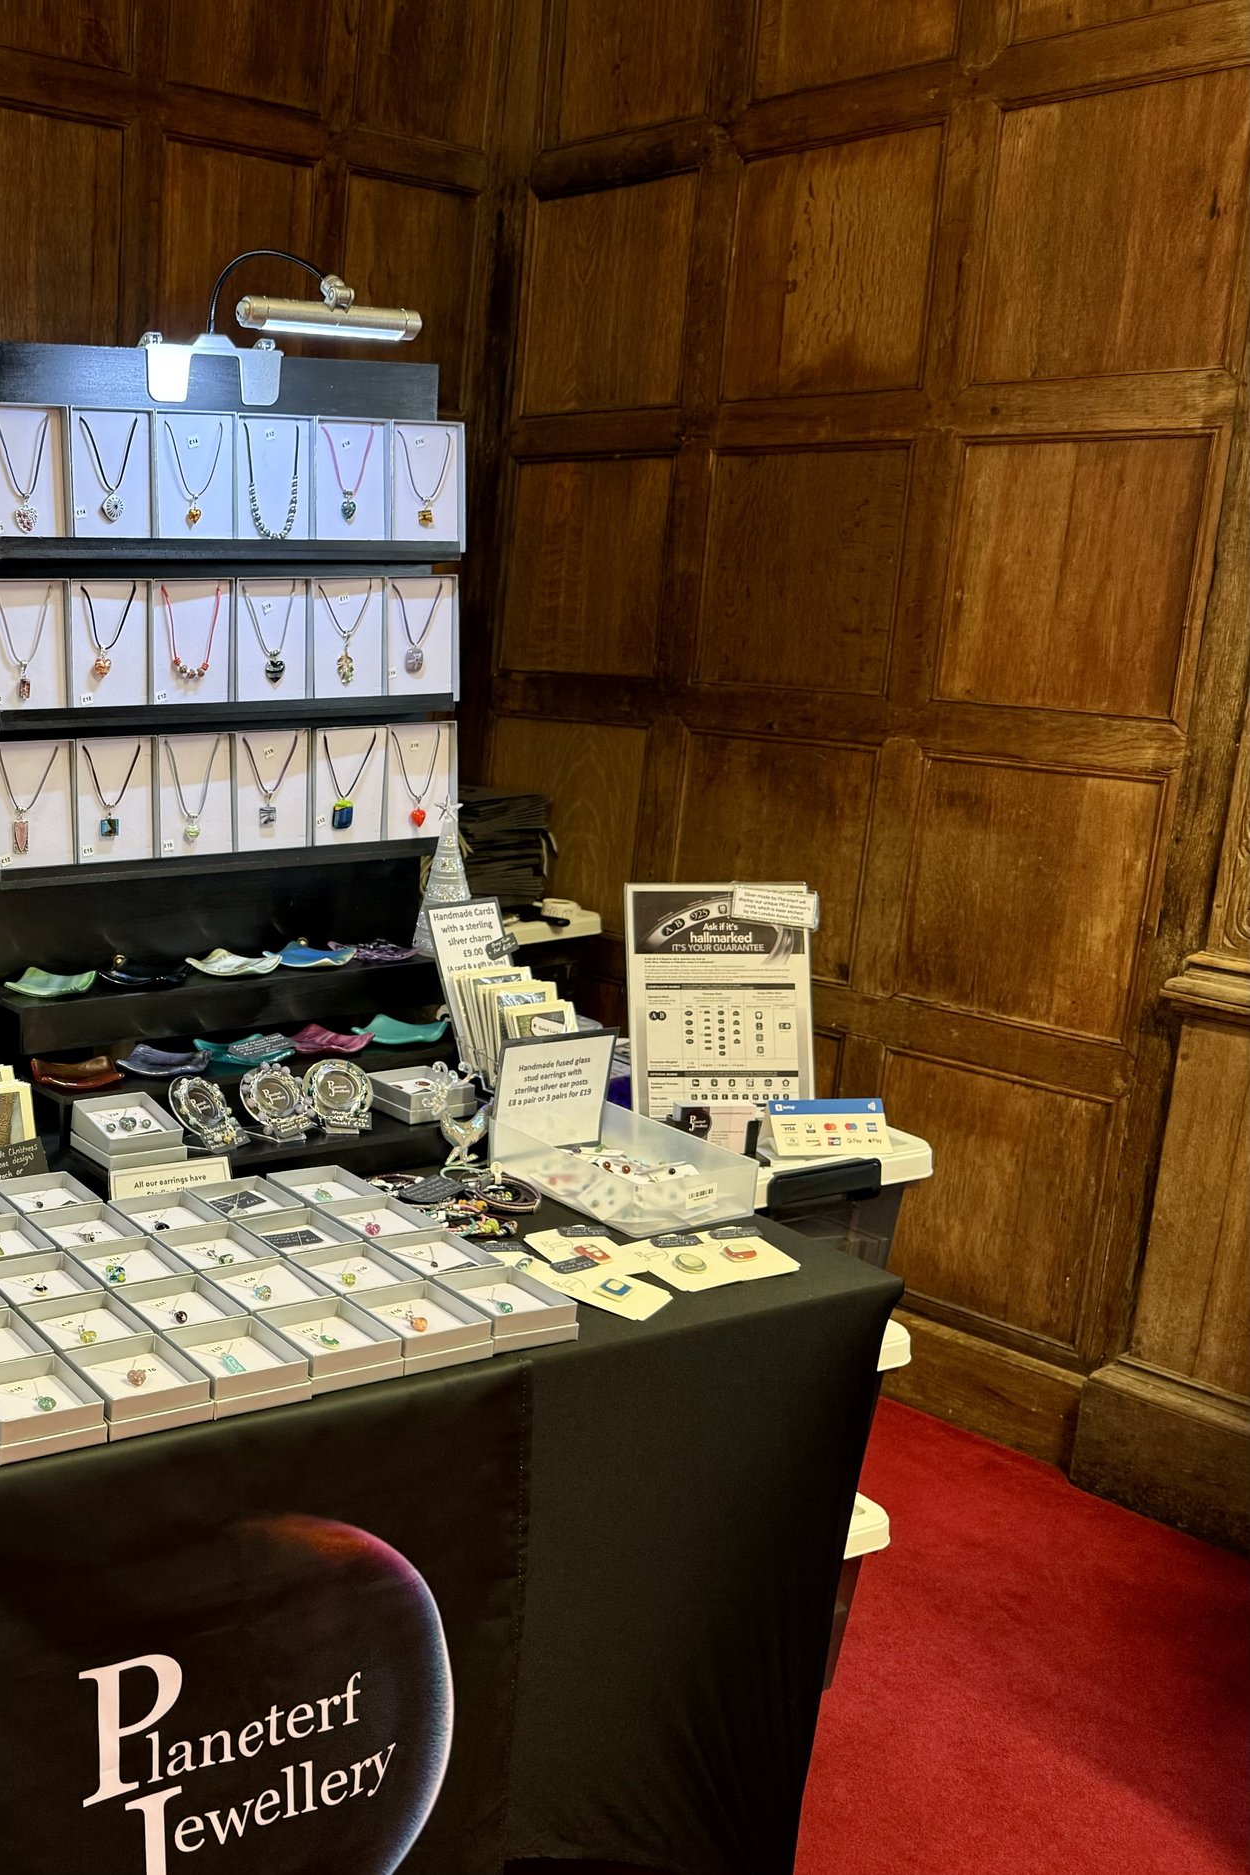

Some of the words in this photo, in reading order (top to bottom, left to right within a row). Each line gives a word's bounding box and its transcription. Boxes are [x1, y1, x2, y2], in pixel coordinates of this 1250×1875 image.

[434, 910, 472, 921] Handmade
[474, 907, 495, 916] Cards
[441, 924, 459, 933] with
[466, 921, 493, 931] sterling
[703, 923, 718, 931] Ask
[719, 923, 725, 931] if
[726, 922, 739, 931] it's
[448, 937, 468, 946] silver
[469, 934, 492, 943] charm
[690, 932, 753, 943] hallmarked
[463, 947, 483, 958] £9.00
[518, 1061, 554, 1072] Handmade
[555, 1059, 574, 1067] fused
[575, 1057, 591, 1066] glass
[524, 1074, 539, 1082] stud
[540, 1071, 566, 1080] earrings
[568, 1068, 582, 1076] with
[514, 1084, 539, 1095] sterling
[540, 1082, 558, 1091] silver
[570, 1079, 588, 1089] posts
[508, 1099, 517, 1107] £8
[523, 1097, 536, 1106] pair
[551, 1091, 567, 1101] pairs
[568, 1090, 578, 1098] for
[579, 1088, 592, 1097] £19
[8, 1144, 38, 1157] Christmas
[134, 1181, 144, 1189] All
[159, 1176, 188, 1185] earrings
[189, 1174, 206, 1182] have
[78, 1654, 362, 1808] Planeterf
